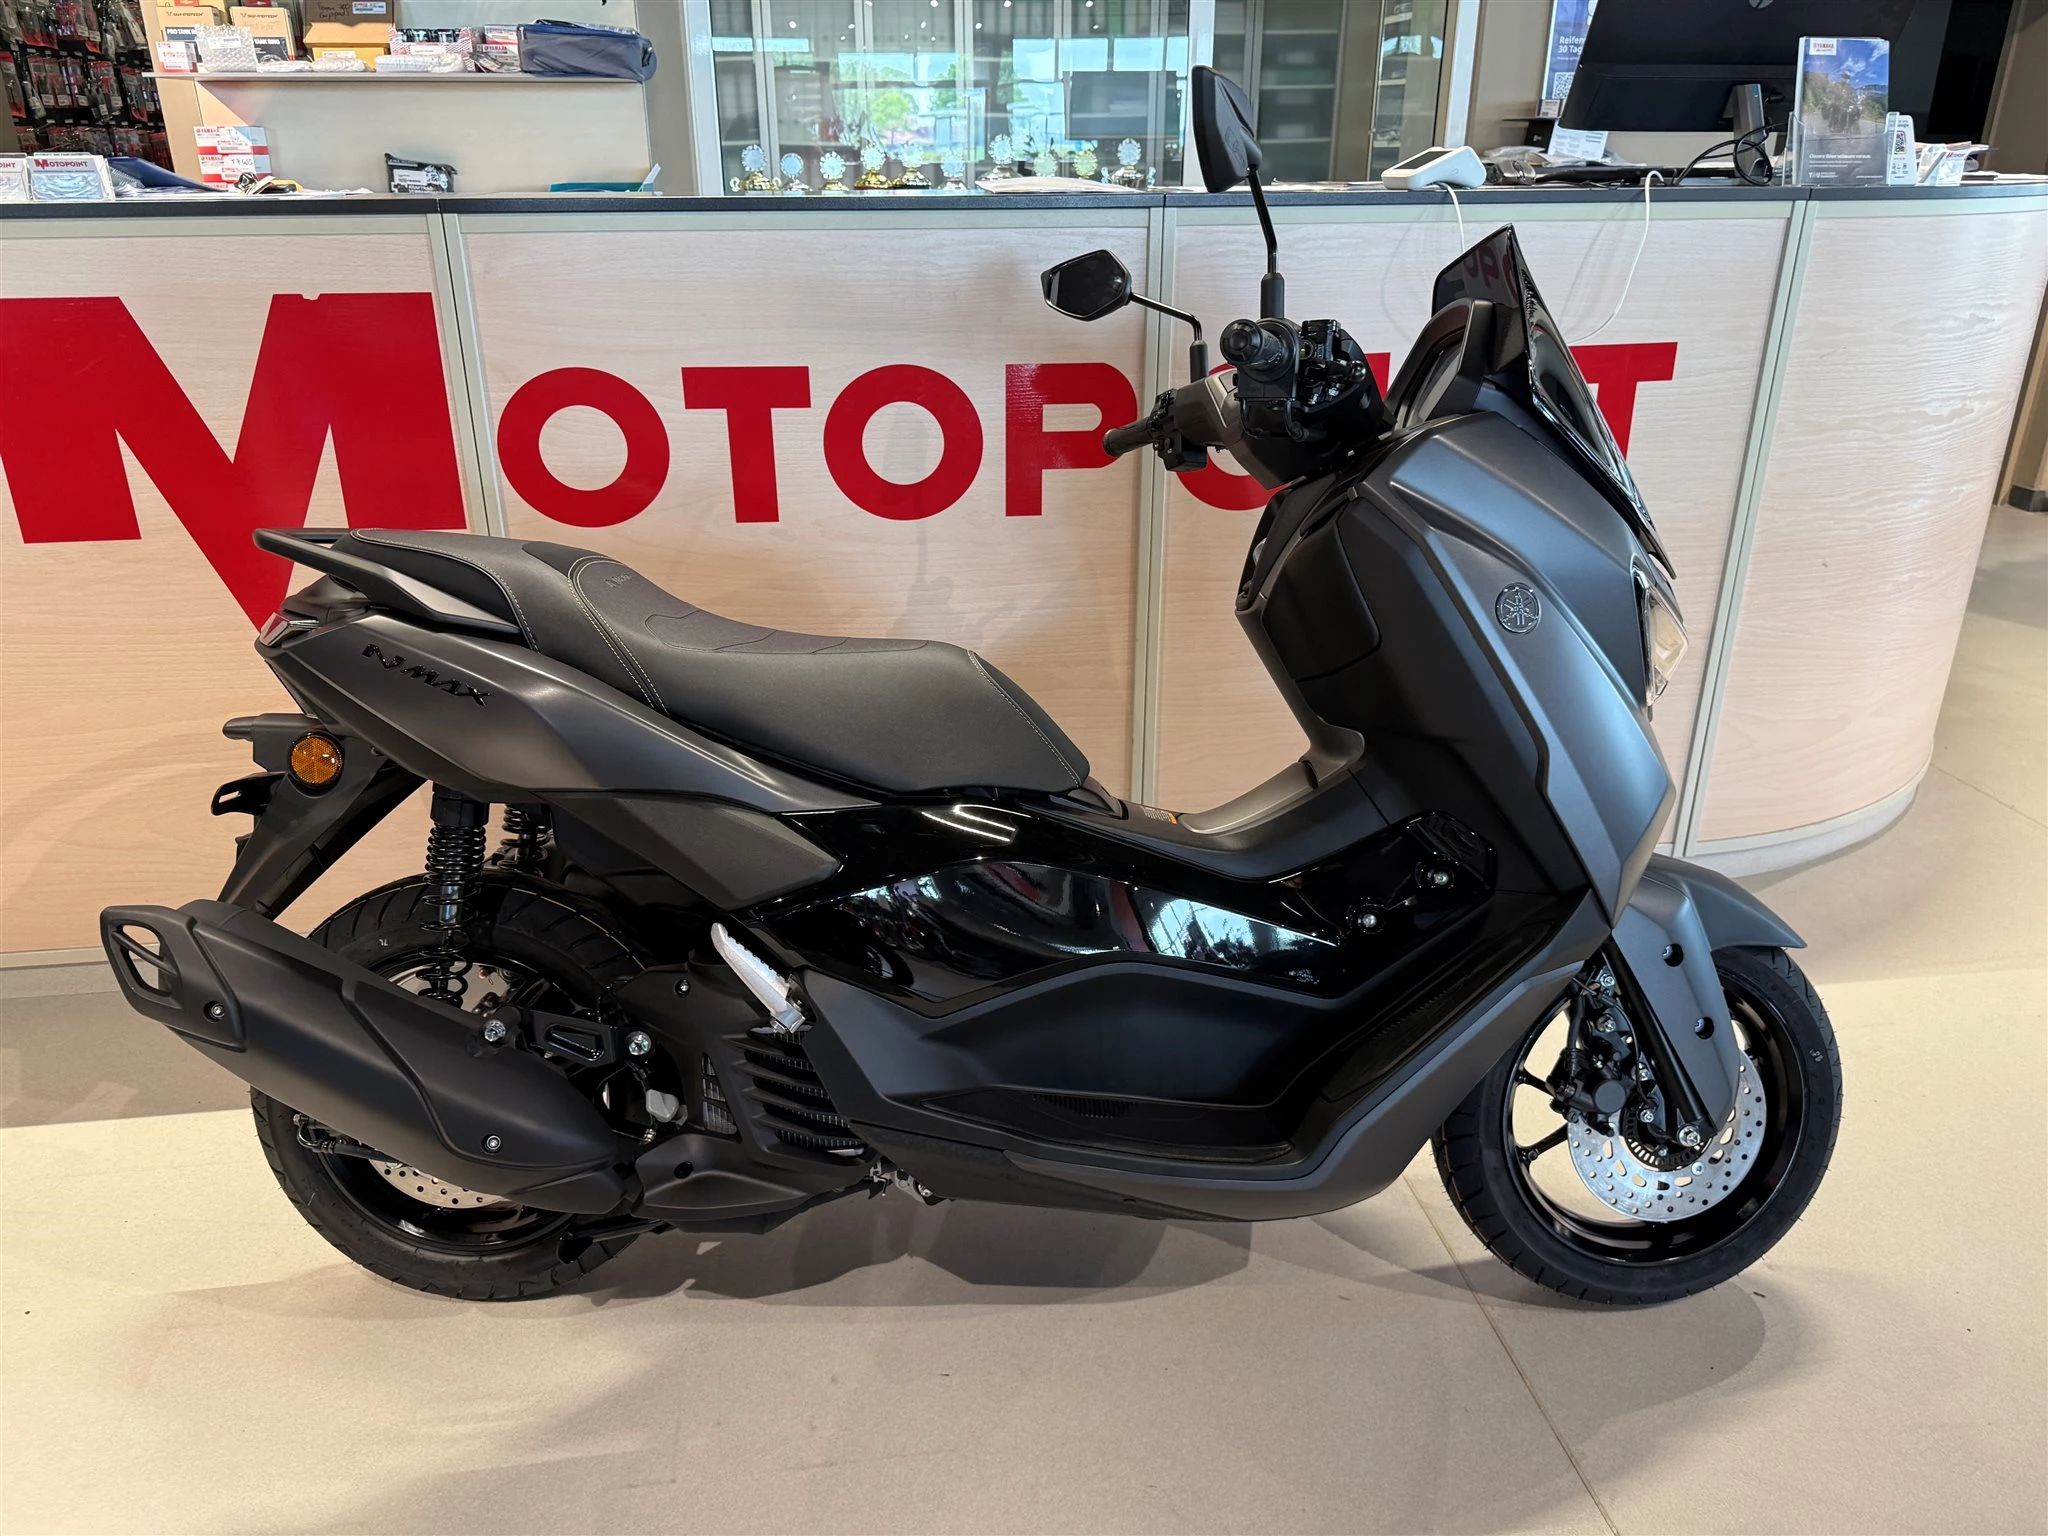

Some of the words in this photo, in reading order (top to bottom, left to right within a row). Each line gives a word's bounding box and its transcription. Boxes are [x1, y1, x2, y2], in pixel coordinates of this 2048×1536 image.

[1559, 36, 1584, 44] Reifen
[1558, 45, 1568, 54] 30
[34, 159, 88, 169] MOTOPOINT
